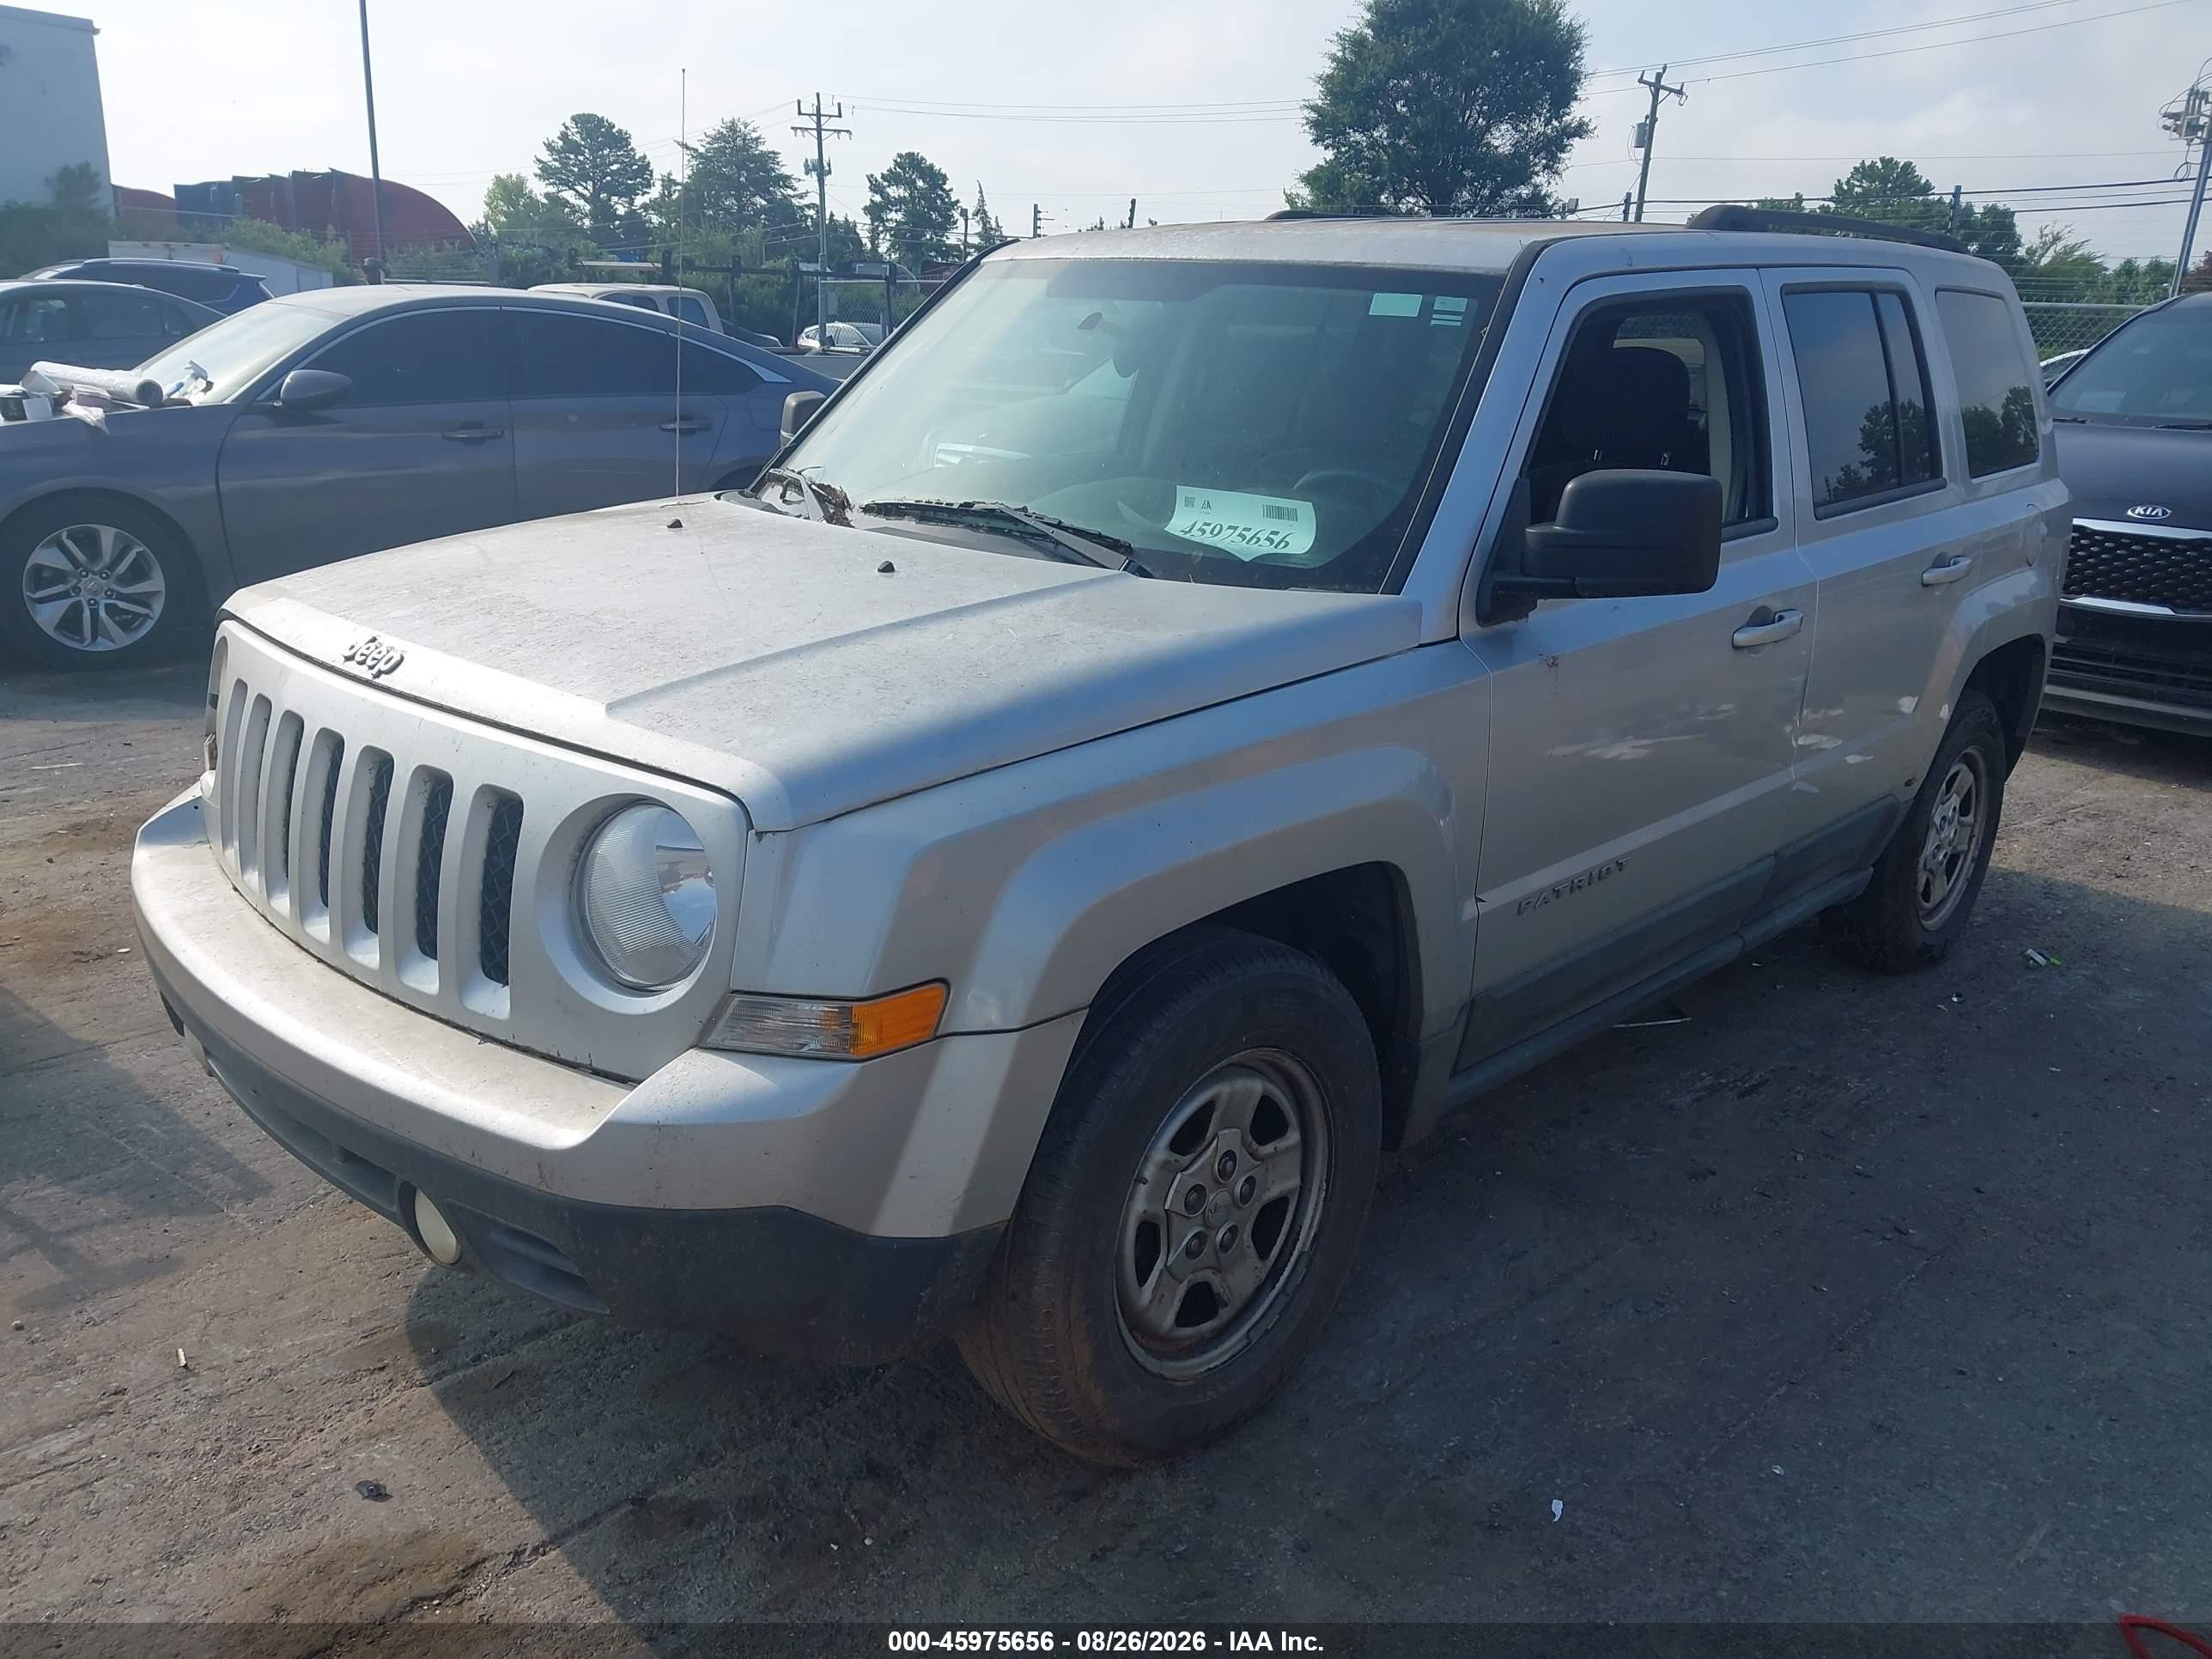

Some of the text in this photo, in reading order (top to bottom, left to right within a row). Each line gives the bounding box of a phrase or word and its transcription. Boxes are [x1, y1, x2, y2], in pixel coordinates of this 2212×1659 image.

[2134, 506, 2163, 517] KIA
[1179, 520, 1295, 550] 45975656
[343, 635, 404, 679] Jeep
[1516, 857, 1631, 916] PATRIOT
